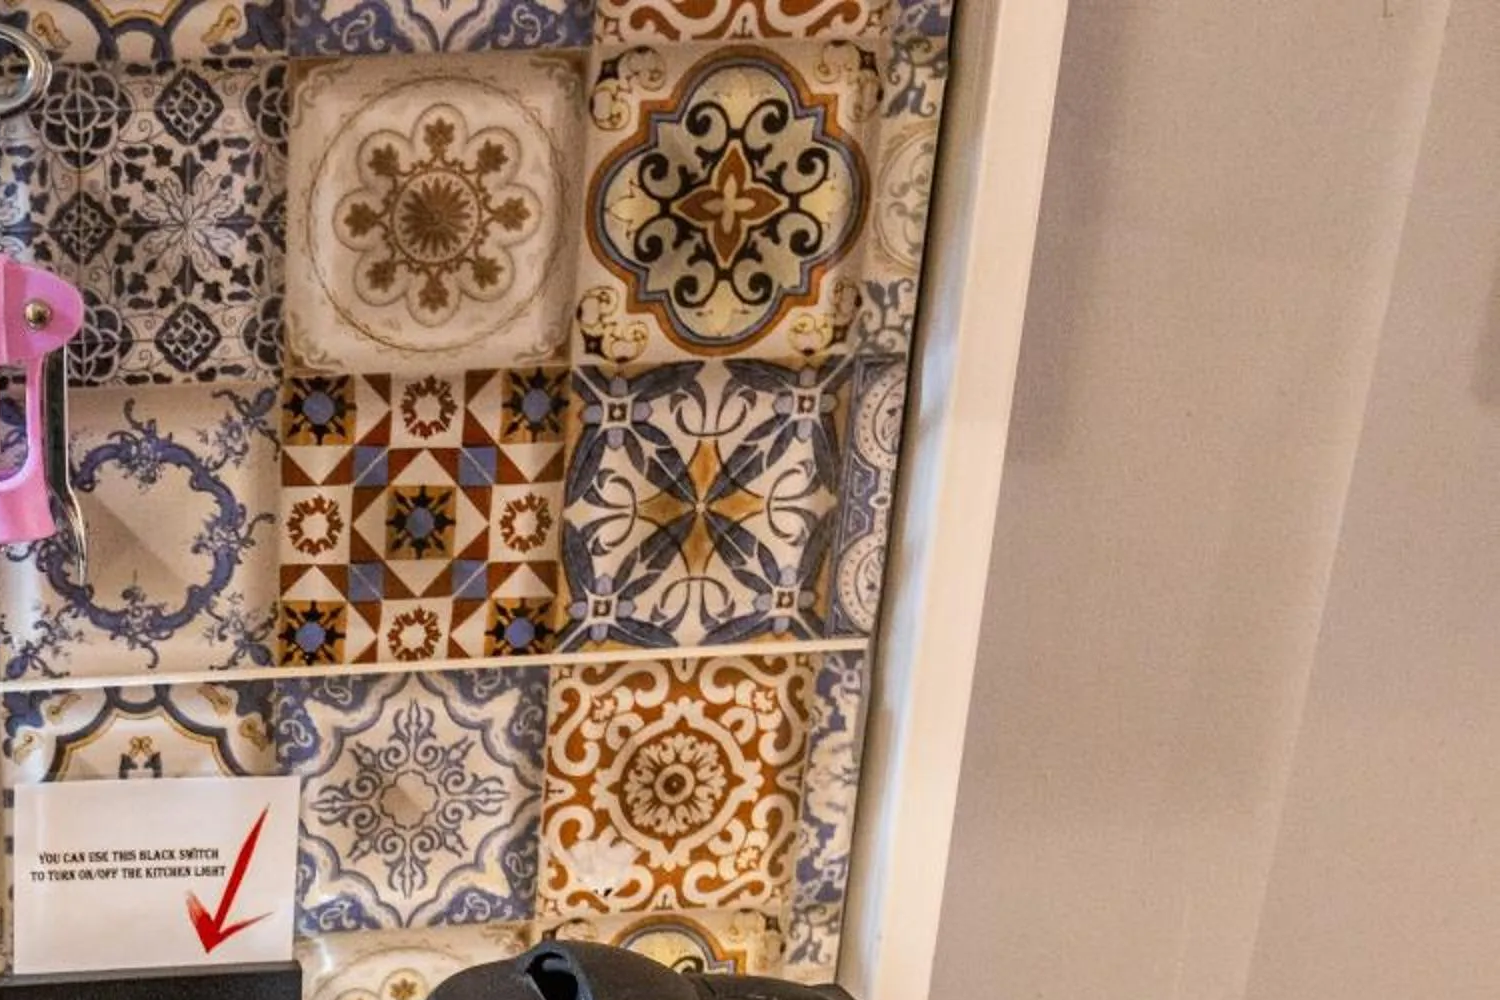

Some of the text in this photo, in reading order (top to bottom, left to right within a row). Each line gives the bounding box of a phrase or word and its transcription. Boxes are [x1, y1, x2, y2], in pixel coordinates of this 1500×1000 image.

[39, 851, 60, 864] YOU
[62, 851, 86, 864] CAN
[87, 850, 109, 863] USE
[112, 849, 137, 862] THIS
[138, 848, 176, 861] BLACK
[31, 864, 227, 882] TO TURN ON/OFF THE KITCHEN LIGHT
